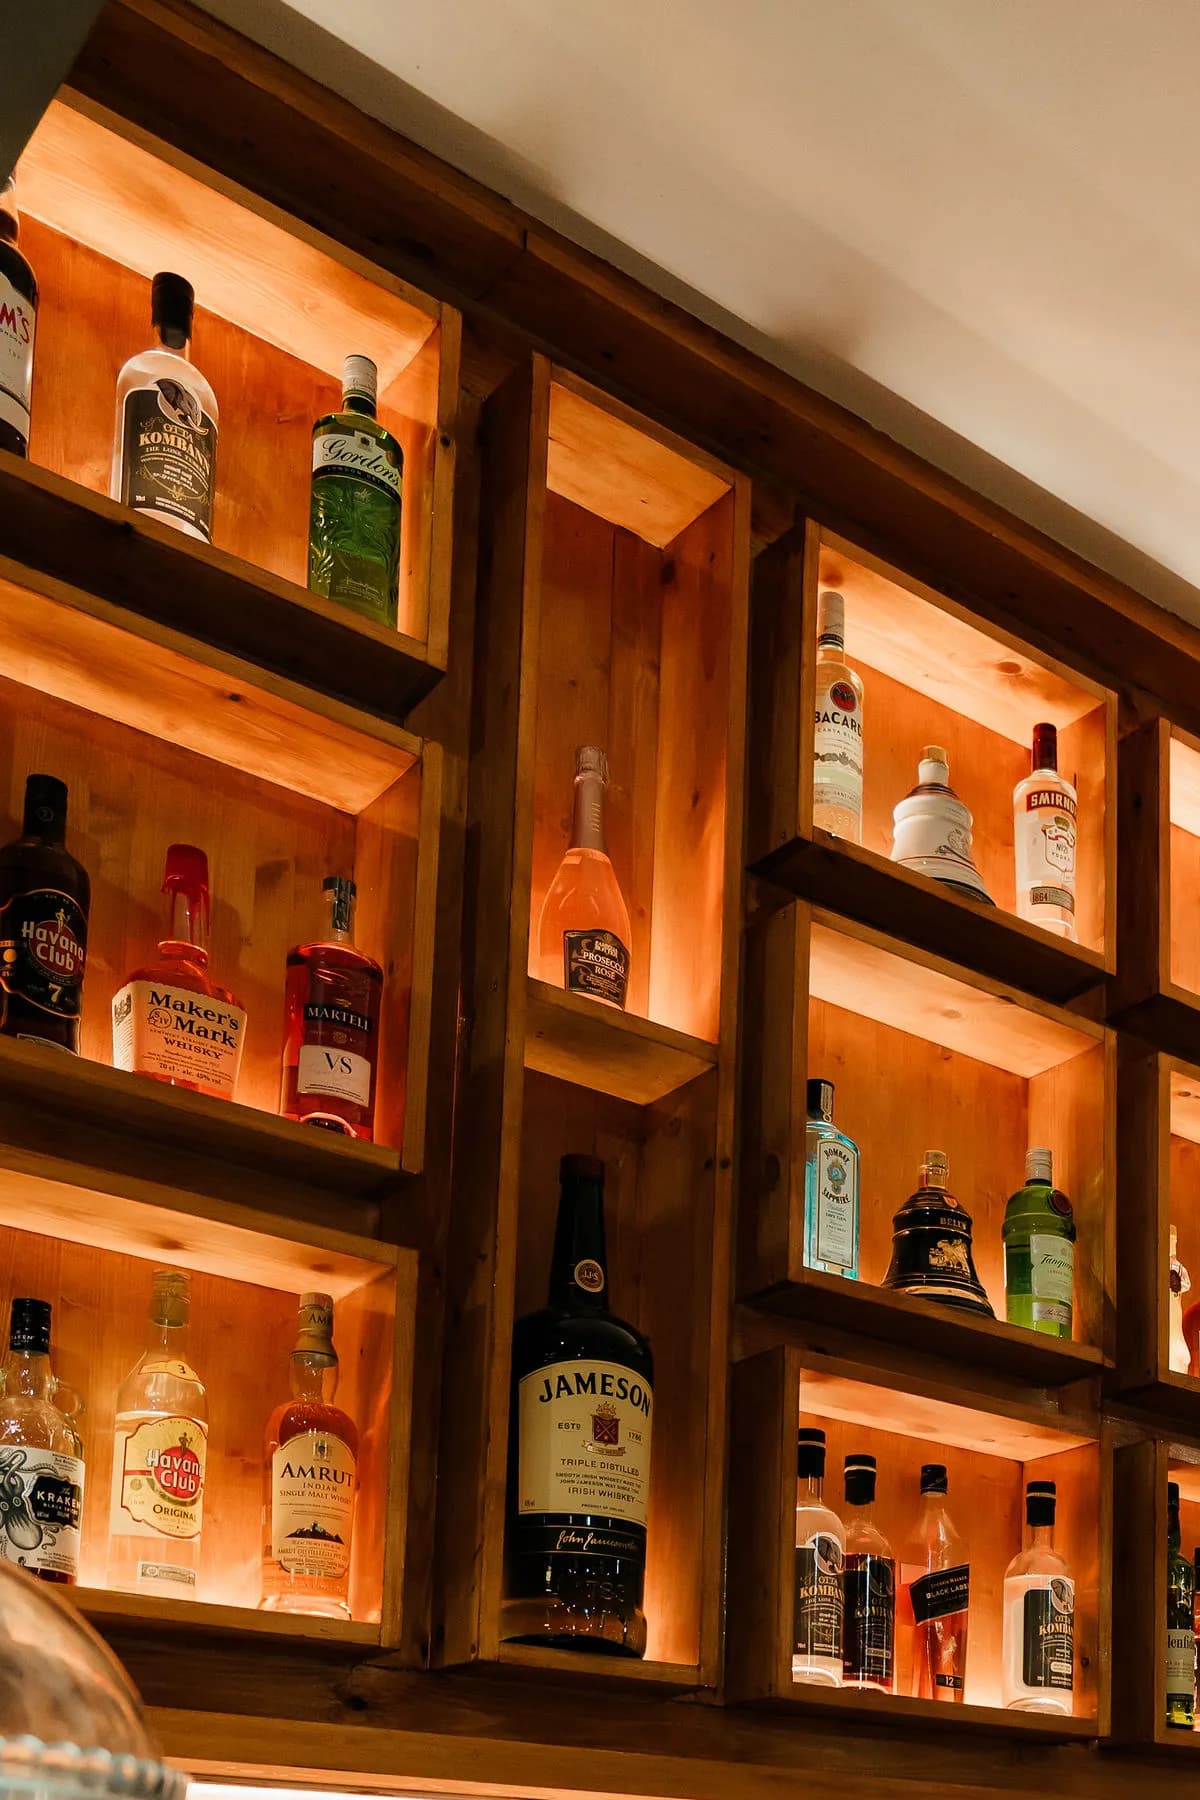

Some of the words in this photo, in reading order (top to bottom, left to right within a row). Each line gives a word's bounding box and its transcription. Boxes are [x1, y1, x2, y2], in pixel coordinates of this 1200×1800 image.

[322, 438, 400, 487] Gordon's
[22, 920, 84, 962] Havana
[36, 943, 75, 972] Club
[583, 951, 625, 974] PROSECCO
[48, 982, 62, 1003] 7
[148, 990, 239, 1031] Maker's
[308, 1006, 370, 1032] MARTELL
[173, 1014, 238, 1049] Mark
[163, 1036, 223, 1060] WHISKY
[324, 1052, 353, 1075] VS
[539, 1372, 650, 1419] JAMESON
[280, 1461, 353, 1487] AMRUT
[561, 1458, 597, 1468] TRIPLE
[600, 1462, 640, 1477] DISTILLED
[160, 1469, 196, 1493] Club
[302, 1482, 338, 1493] INDIAN
[36, 1490, 81, 1508] KRAKEN
[279, 1490, 306, 1498] SINGLE
[307, 1491, 329, 1500] MALT
[568, 1487, 596, 1496] IRISH
[598, 1490, 635, 1504] WHISKEY
[152, 1503, 197, 1522] ORIGINAL
[556, 1530, 584, 1550] John
[926, 1588, 949, 1600] BLACK
[945, 1675, 954, 1687] 12
